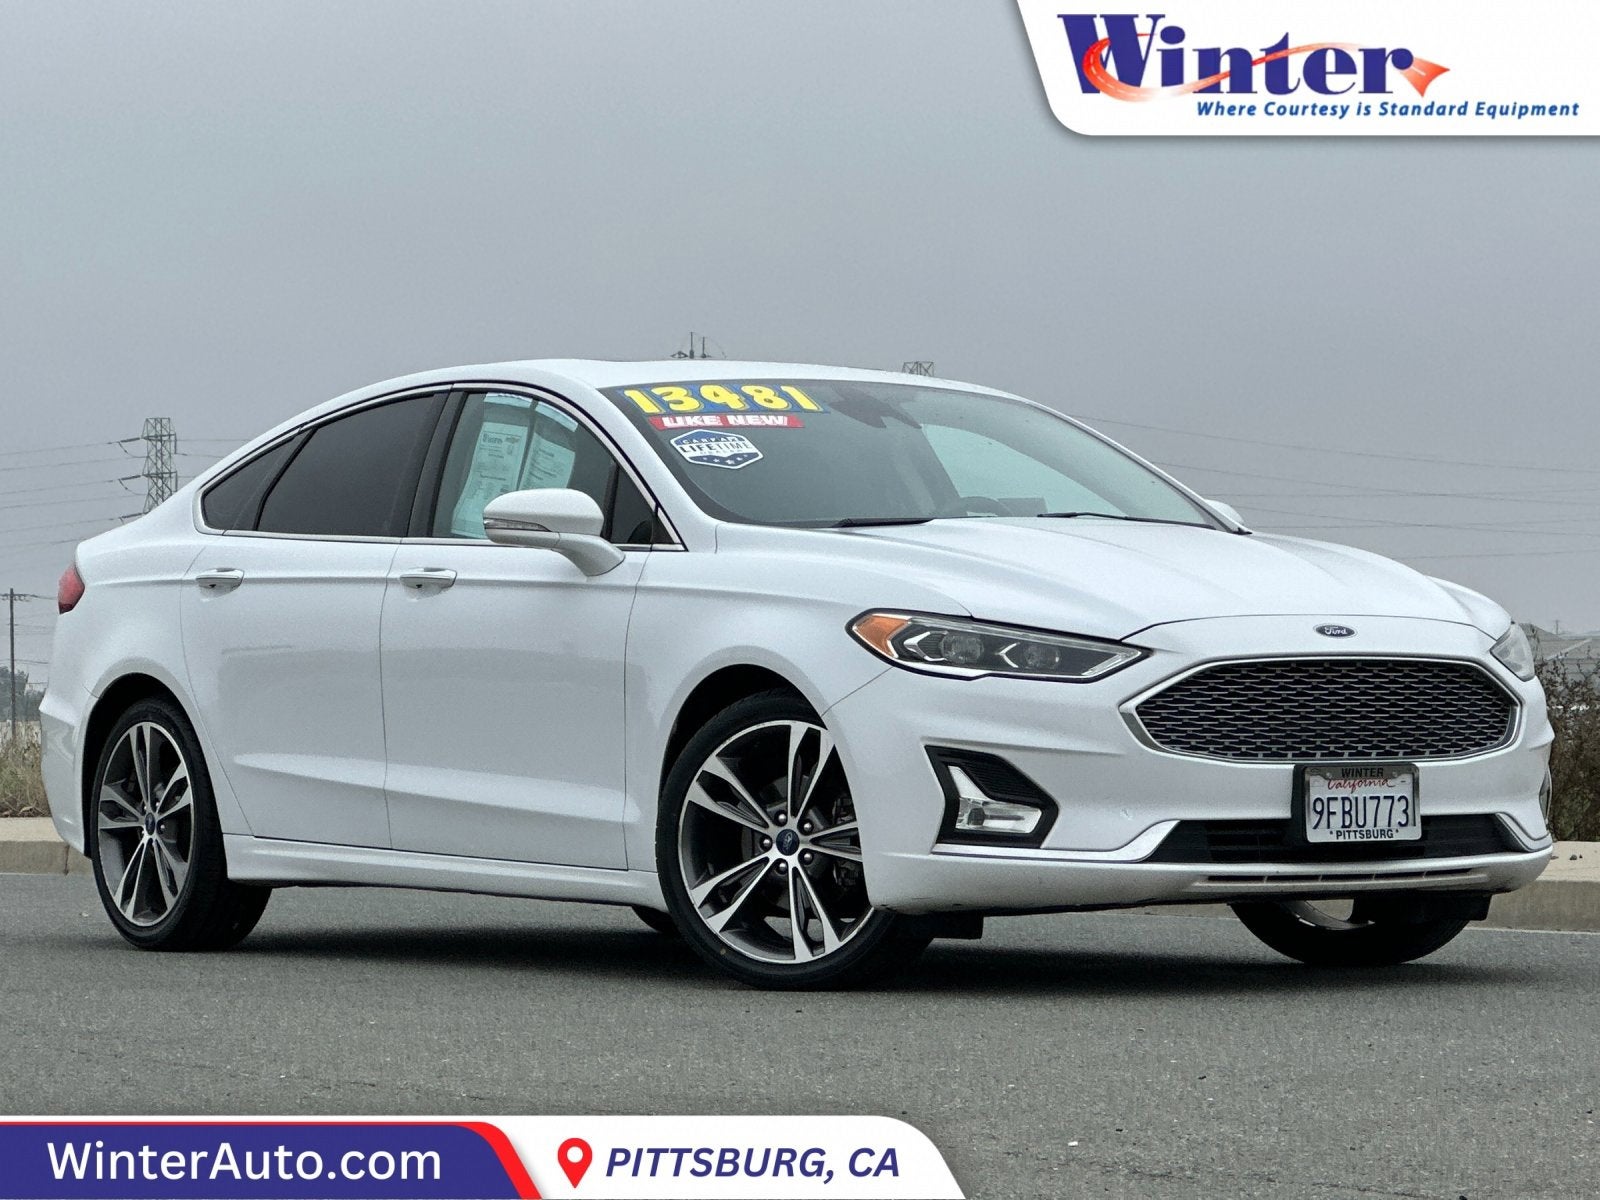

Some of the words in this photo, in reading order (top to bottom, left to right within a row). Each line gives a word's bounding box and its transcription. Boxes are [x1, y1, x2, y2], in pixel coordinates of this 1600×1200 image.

[624, 384, 820, 415] 13481
[678, 442, 754, 454] LIFETIME
[1324, 626, 1348, 635] Ford
[1341, 767, 1384, 778] WINTER
[1327, 778, 1396, 795] California
[1312, 795, 1409, 830] 9FBU773
[1335, 829, 1394, 839] PITTSBURG
